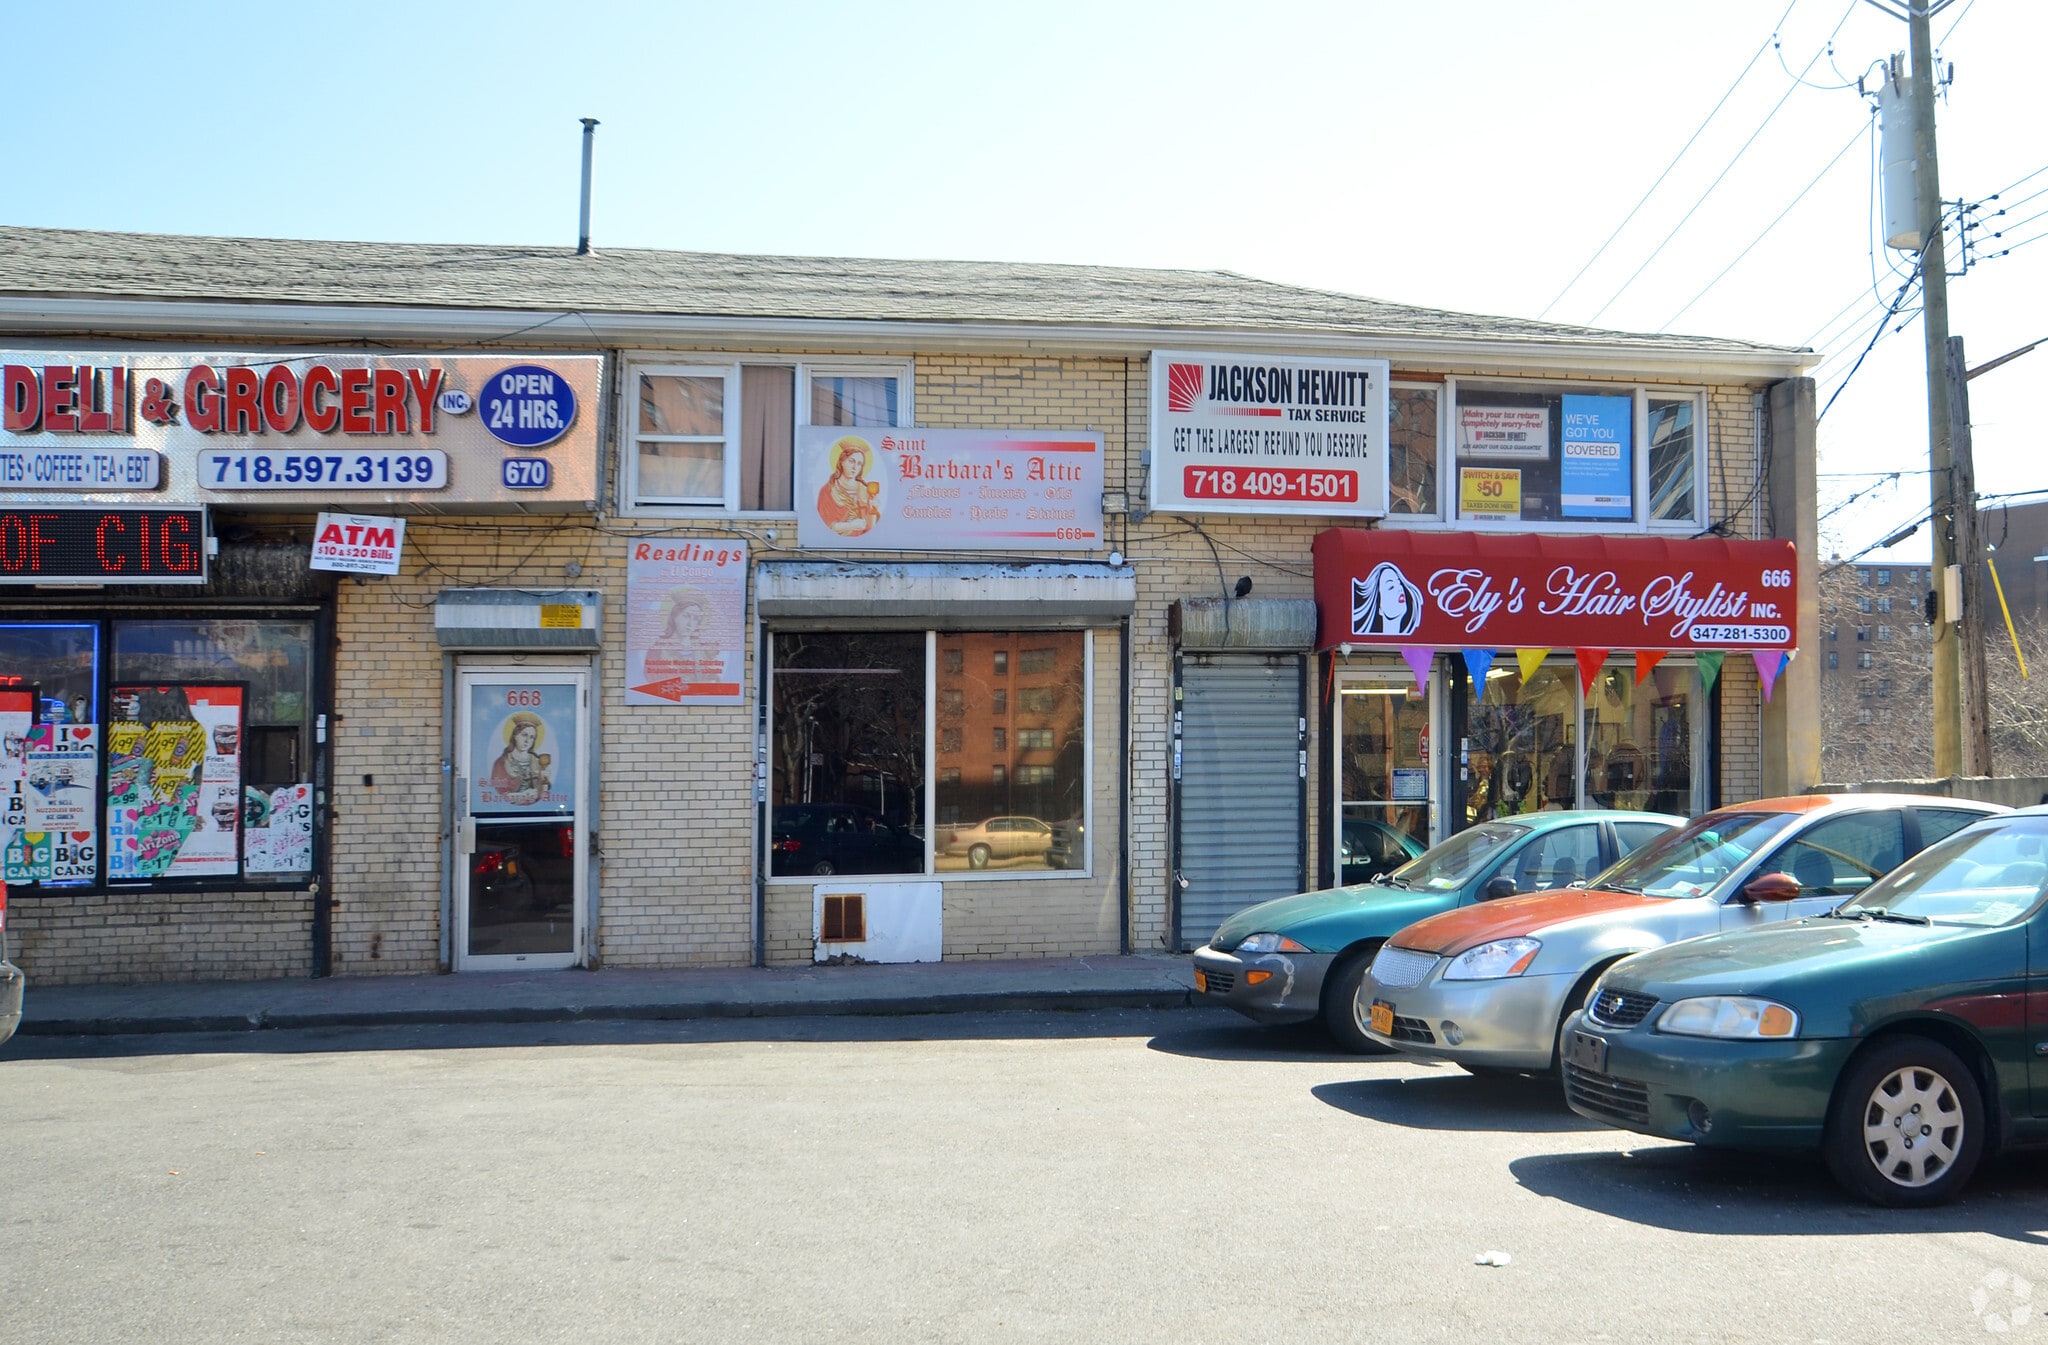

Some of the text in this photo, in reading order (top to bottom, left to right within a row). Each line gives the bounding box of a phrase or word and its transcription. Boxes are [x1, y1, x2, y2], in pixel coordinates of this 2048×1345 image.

[501, 374, 554, 395] OPEN
[1209, 365, 1369, 407] JACKSON HEWITT
[3, 364, 443, 434] DELI & GROCERY
[443, 394, 468, 409] INC.
[490, 398, 564, 430] 24 HRS.
[1288, 408, 1366, 423] TAX SERVICE
[1464, 410, 1484, 418] Make
[1485, 411, 1503, 420] your
[1504, 411, 1515, 419] tax
[1565, 414, 1599, 425] WE'VE
[1461, 419, 1543, 430] completely worry-free!
[1565, 427, 1614, 439] GOT YOU
[881, 436, 926, 451] Saint
[1173, 427, 1368, 459] GET THE LARGEST REFUND YOU DESERVE
[1566, 445, 1618, 456] COVERED.
[35, 454, 82, 482] COFFEE
[93, 456, 116, 482] TEA
[127, 456, 150, 482] EBT
[212, 456, 433, 482] 718.597.3139
[505, 461, 545, 486] 670
[899, 454, 1082, 481] Barbara's Attic
[1463, 471, 1492, 480] SWITCH
[1501, 472, 1519, 480] SAVE
[1191, 470, 1351, 497] 718 409-1501
[1477, 480, 1503, 497] $50
[907, 485, 1072, 500] Flowers Incense Oils
[902, 506, 952, 519] Candles
[970, 505, 1008, 522] Herbs
[0, 514, 198, 571] OF CIG
[318, 524, 395, 548] ATM
[1056, 528, 1082, 540] 668
[318, 546, 337, 556] $10
[347, 548, 368, 558] $20
[370, 549, 394, 559] Bills
[635, 543, 742, 567] Readings
[1761, 569, 1791, 588] 666
[1427, 565, 1782, 639] Ely's Hair Stylist INC.
[1693, 628, 1787, 640] 347-281-5300
[507, 690, 542, 706] 668
[7, 866, 50, 877] CANS
[55, 865, 95, 876] CANS
